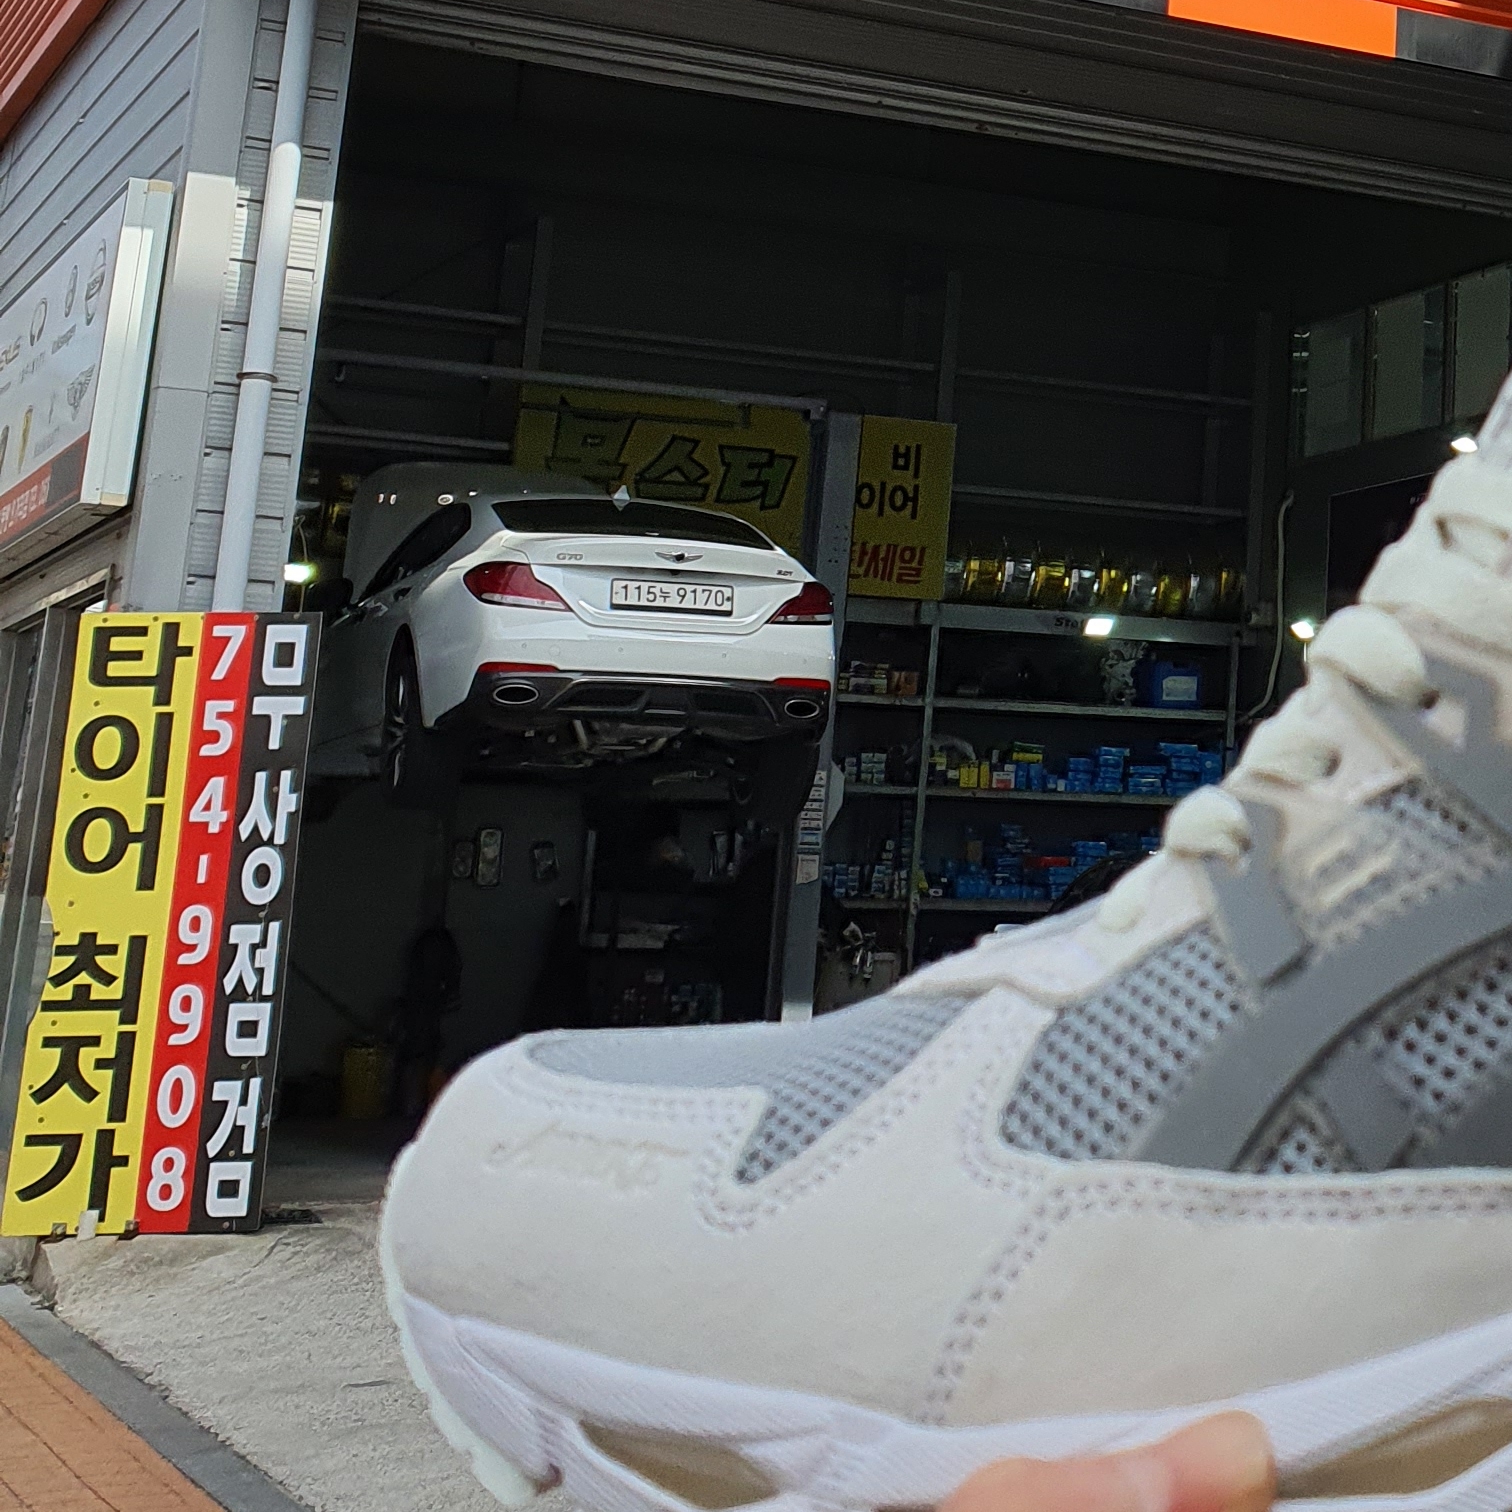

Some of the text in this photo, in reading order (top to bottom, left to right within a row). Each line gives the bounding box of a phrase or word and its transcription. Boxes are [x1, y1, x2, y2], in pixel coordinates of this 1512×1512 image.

[556, 552, 584, 561] G70
[620, 583, 726, 608] 115누 9170
[15, 622, 194, 1226] 타이어 최저가
[145, 623, 248, 1213] 754-9908
